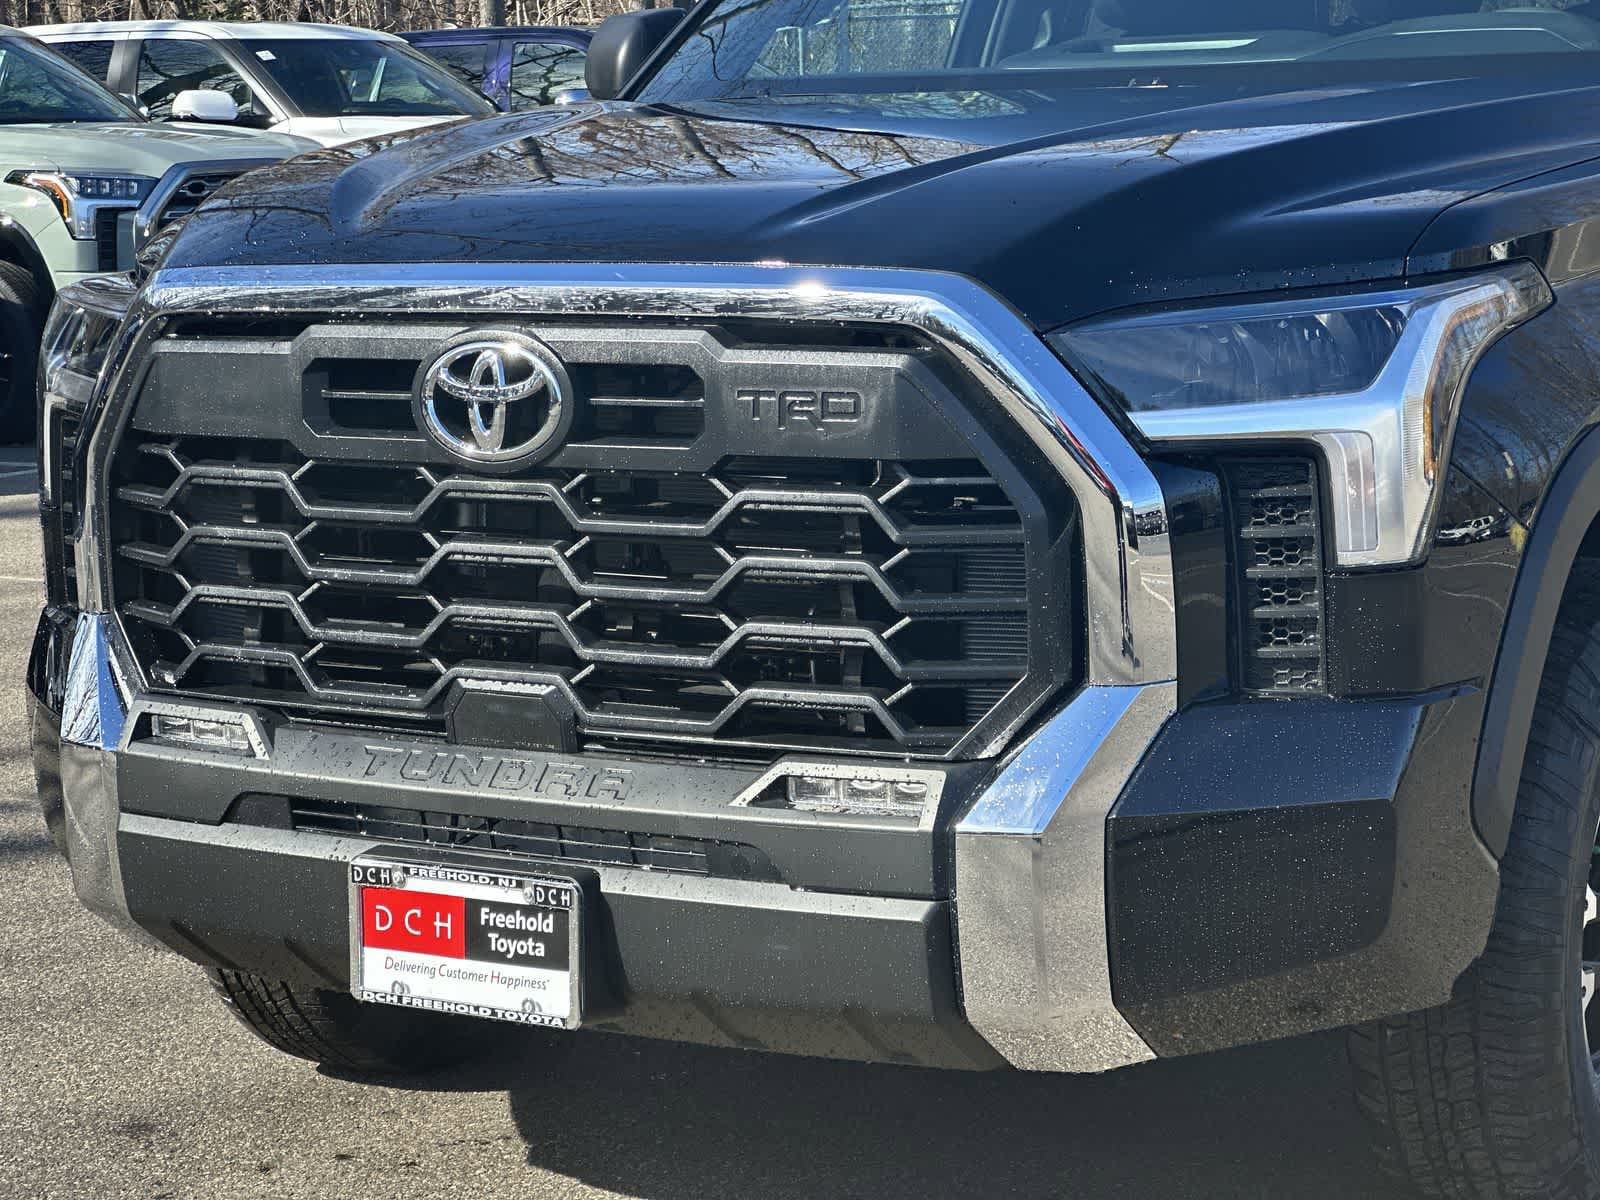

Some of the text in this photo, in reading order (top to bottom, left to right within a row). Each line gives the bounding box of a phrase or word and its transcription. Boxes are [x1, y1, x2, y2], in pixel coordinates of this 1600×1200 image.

[736, 388, 862, 431] TRD
[364, 744, 637, 801] TUNDRA
[409, 866, 518, 889] FREEHOLD, NJ
[480, 907, 554, 934] Freehold
[487, 932, 546, 959] Toyota
[384, 956, 437, 979] Delivering
[438, 963, 489, 984] Customer
[363, 990, 564, 1028] DCH FREEHOLD TOYOTA
